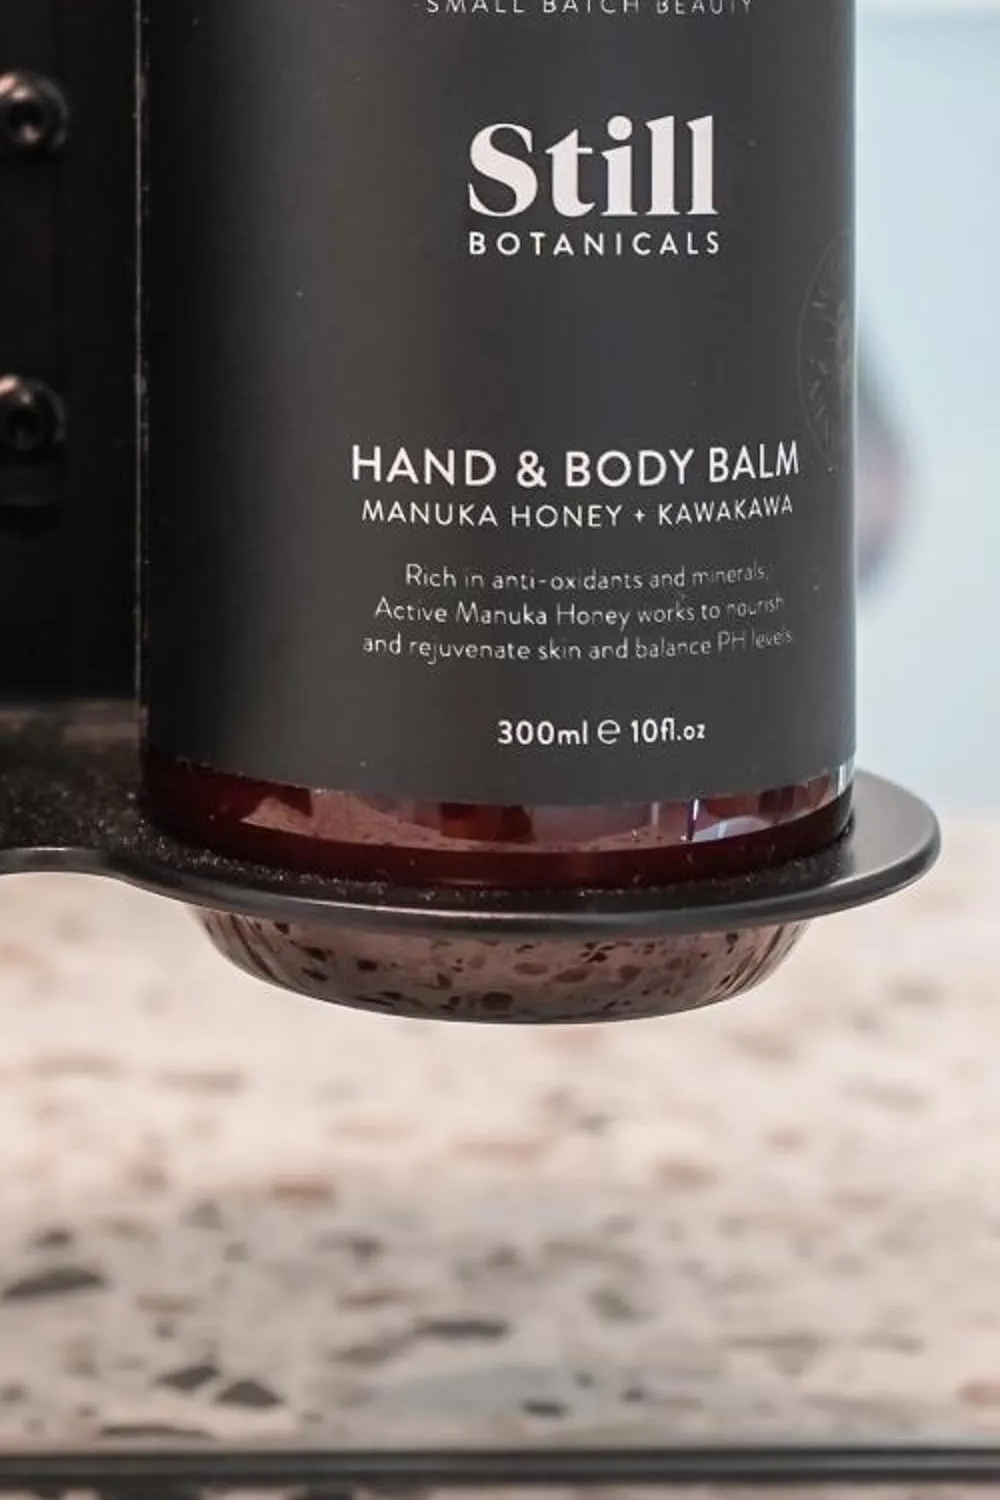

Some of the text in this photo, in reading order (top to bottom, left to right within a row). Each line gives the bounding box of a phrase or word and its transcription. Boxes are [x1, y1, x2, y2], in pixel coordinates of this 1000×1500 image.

[467, 114, 719, 218] Still
[468, 230, 719, 257] BOTANICALS
[351, 439, 800, 489] HAND & BODY BALM
[361, 499, 499, 527] MANUKA
[511, 503, 623, 528] HONEY
[658, 493, 793, 526] KAWAKAWA
[405, 563, 457, 588] Rich
[464, 568, 485, 589] in
[491, 568, 644, 591] anti-oxidants
[648, 565, 686, 589] and
[374, 595, 448, 623] Active
[455, 600, 548, 626] Manuka
[556, 602, 631, 633] Honey
[636, 600, 695, 624] works
[700, 603, 721, 621] to
[363, 632, 402, 655] and
[409, 640, 531, 666] rejuvenate
[537, 638, 582, 661] skin
[588, 636, 629, 661] and
[635, 636, 712, 659] balance
[717, 629, 746, 653] PH
[497, 719, 589, 745] 300ml
[630, 716, 706, 744] 10fl.oz
